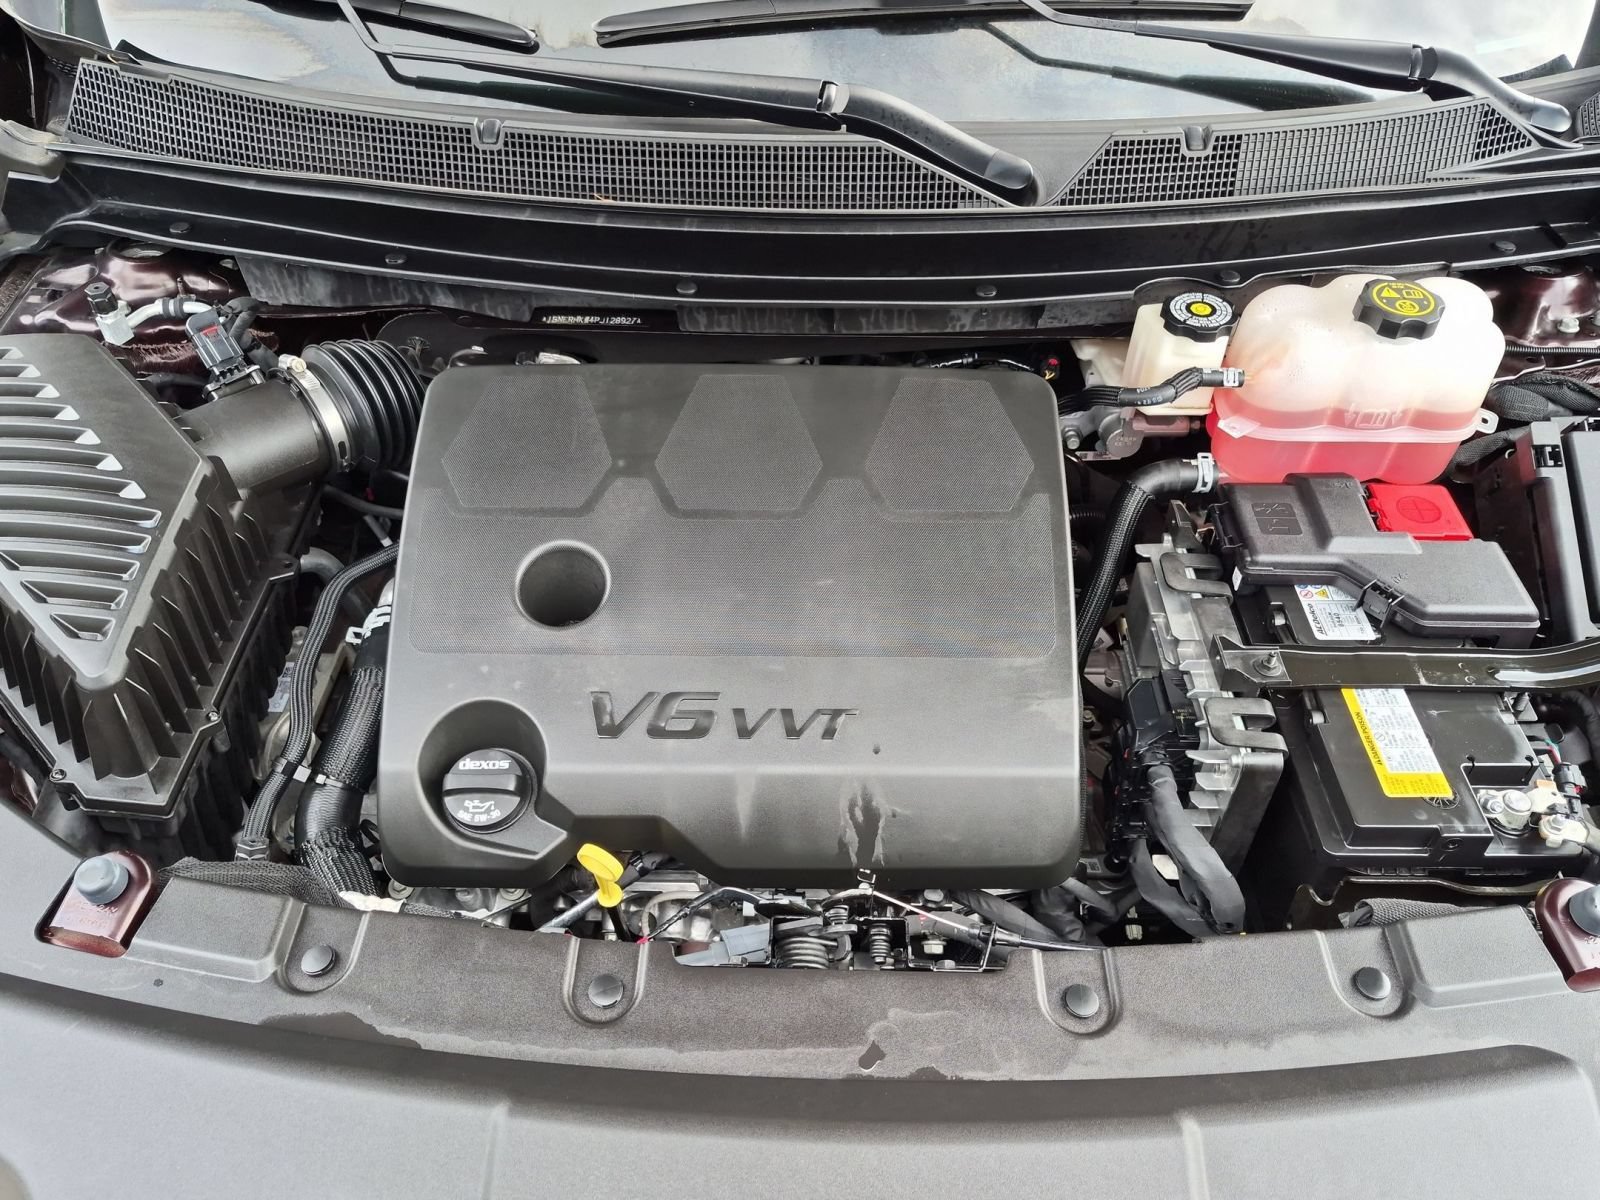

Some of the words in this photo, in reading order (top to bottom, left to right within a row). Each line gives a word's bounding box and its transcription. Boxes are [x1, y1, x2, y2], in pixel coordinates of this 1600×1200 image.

[590, 691, 721, 740] V6
[732, 708, 859, 740] VVT
[1355, 711, 1369, 734] POISON
[1364, 735, 1381, 762] DANGER
[459, 758, 512, 770] dexos
[457, 810, 473, 822] SAE
[474, 809, 501, 823] 5W-30
